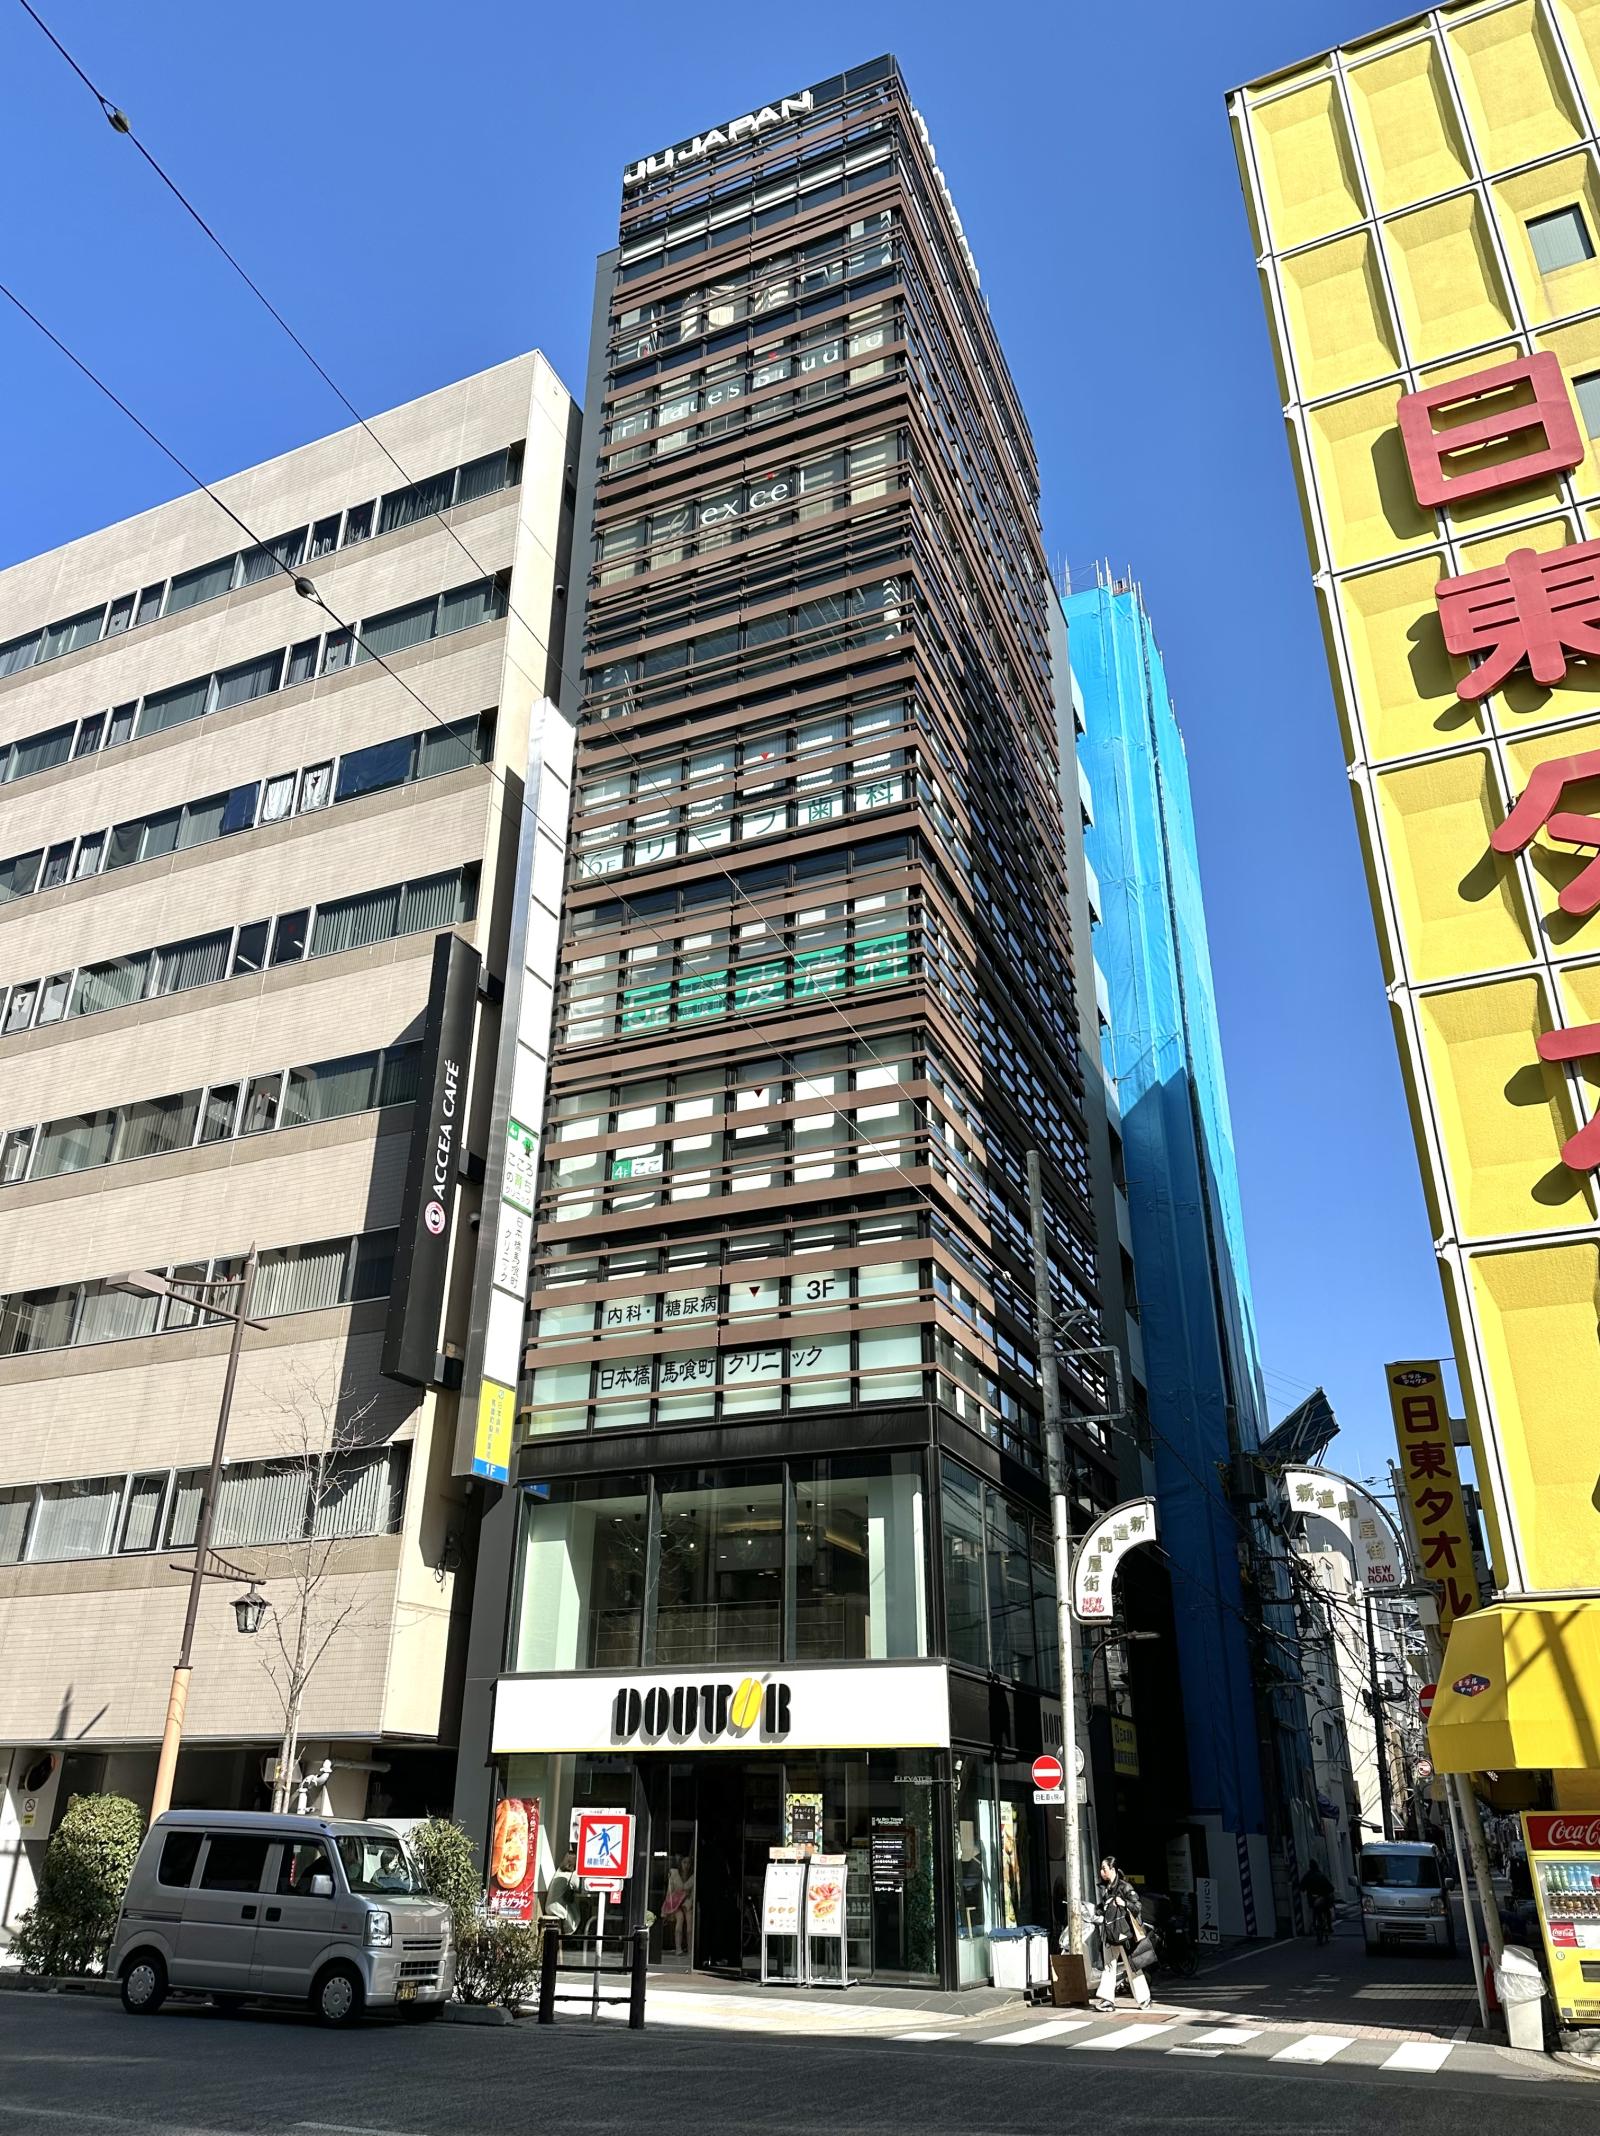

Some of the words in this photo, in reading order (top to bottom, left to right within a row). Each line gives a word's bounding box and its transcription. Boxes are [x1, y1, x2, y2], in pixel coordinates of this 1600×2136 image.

[624, 148, 674, 187] JU
[677, 90, 815, 164] JAPAN
[701, 471, 805, 526] excel
[646, 782, 894, 861] リーフ歯科
[742, 939, 904, 1006] 皮膚科
[442, 1059, 460, 1118] CAFÉ
[433, 1124, 453, 1200] ACCEA
[507, 1151, 534, 1177] こころ
[607, 1294, 717, 1325] 内科・糖尿病
[805, 1278, 836, 1301] 3F
[600, 1345, 823, 1391] 日本橋馬喰町クリニック
[485, 1463, 497, 1478] 1F
[1401, 1395, 1472, 1618] 日東タオル
[1367, 1565, 1391, 1575] NEW
[1367, 1573, 1395, 1584] ROAD
[1081, 1604, 1105, 1613] ROAD
[1082, 1597, 1103, 1606] NEW
[615, 1677, 791, 1736] DOUTOR
[1203, 1879, 1213, 1919] クリニック
[1200, 1933, 1219, 1942] 入口
